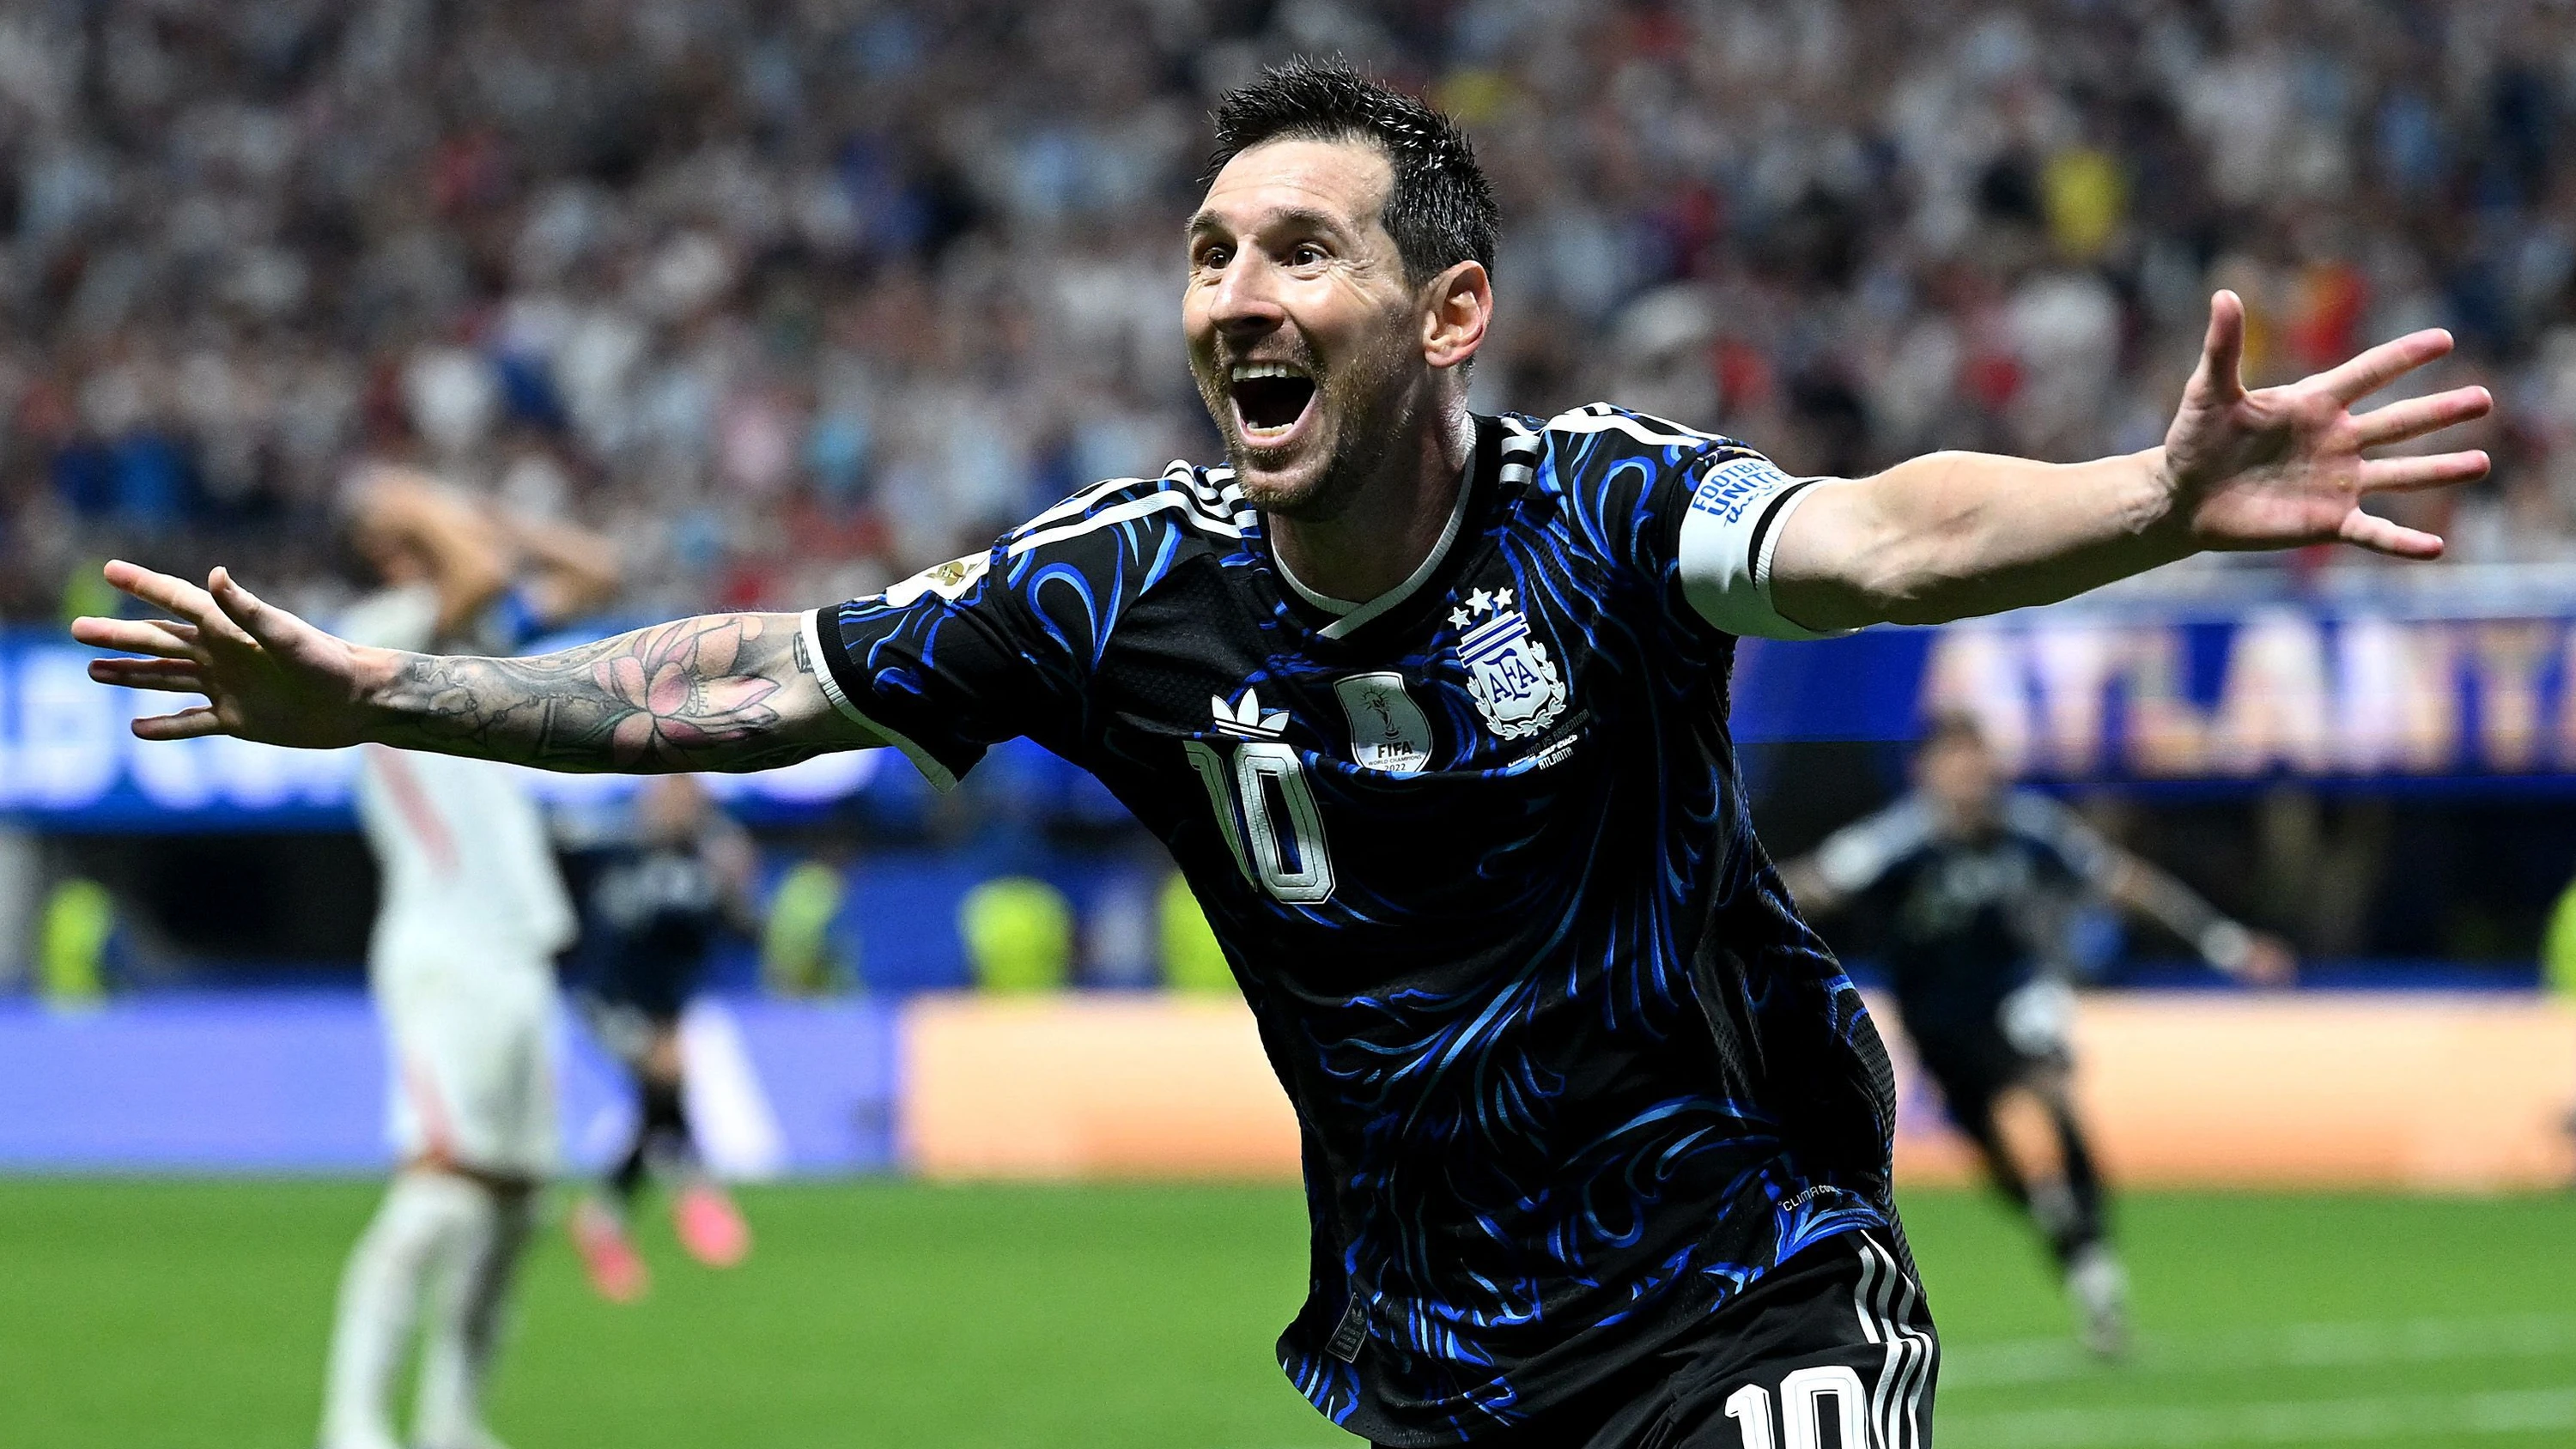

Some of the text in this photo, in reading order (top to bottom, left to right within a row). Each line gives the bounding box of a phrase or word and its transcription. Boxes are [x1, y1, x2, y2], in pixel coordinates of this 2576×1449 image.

[1692, 462, 1775, 511] FOOTBA
[1482, 647, 1540, 704] AFA
[1911, 615, 2576, 778] ATLANT
[1552, 708, 1591, 741] ARGENTINA
[1377, 741, 1413, 758] FIFA
[1384, 763, 1406, 772] 2022
[1389, 755, 1422, 764] CHAMPIONS
[1537, 746, 1574, 770] ATLANTA
[1182, 740, 1336, 905] 10
[1724, 1365, 1872, 1449] 10
